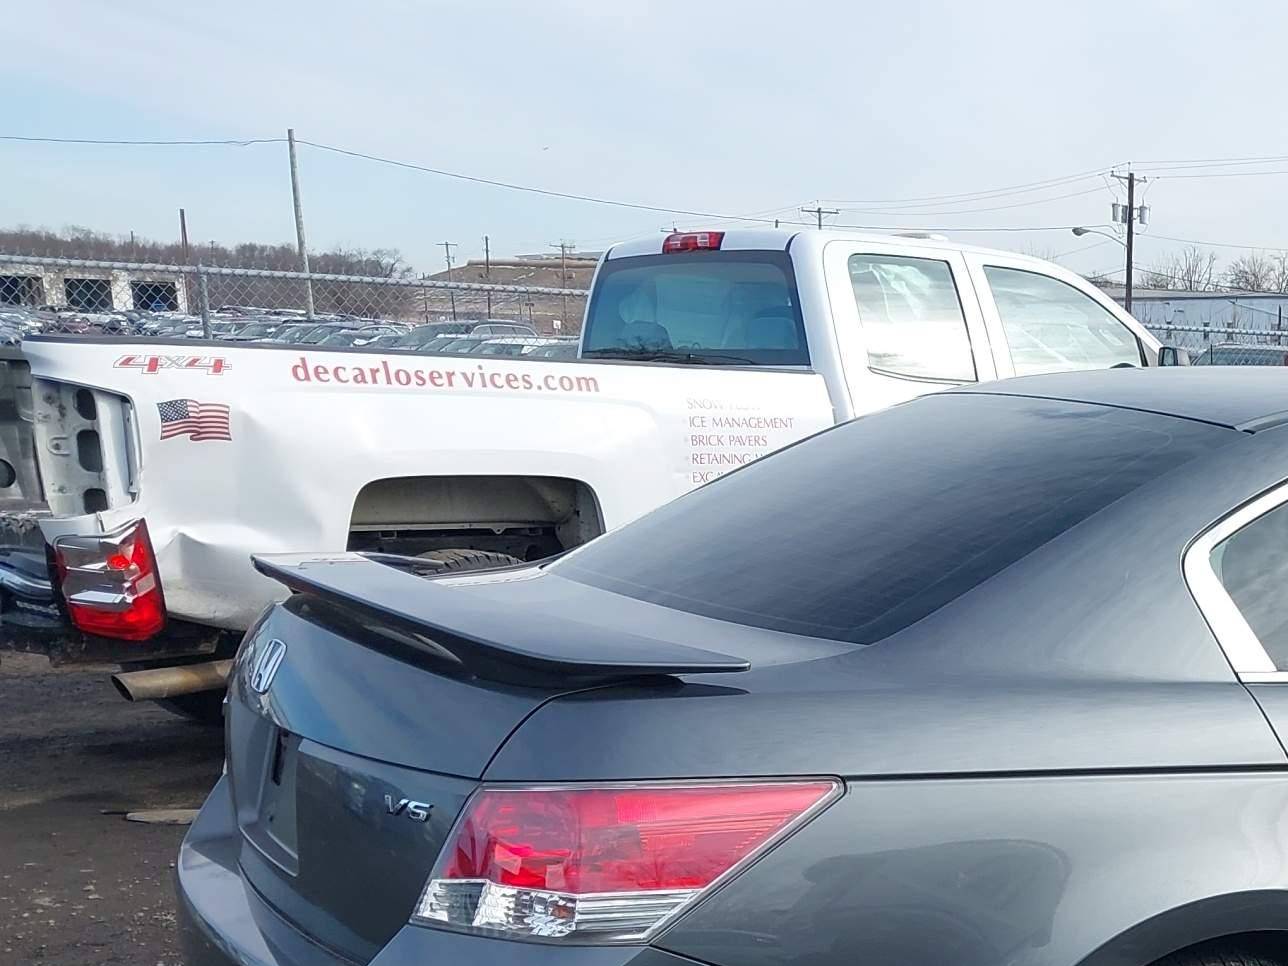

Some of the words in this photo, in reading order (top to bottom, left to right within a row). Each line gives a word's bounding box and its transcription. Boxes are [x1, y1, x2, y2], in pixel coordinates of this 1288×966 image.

[291, 356, 600, 393] decarloservices.com
[688, 415, 707, 428] ICE
[712, 416, 794, 429] MANAGEMENT
[690, 434, 724, 447] BRICK
[729, 434, 768, 447] PAVERS
[384, 793, 434, 822] V6
